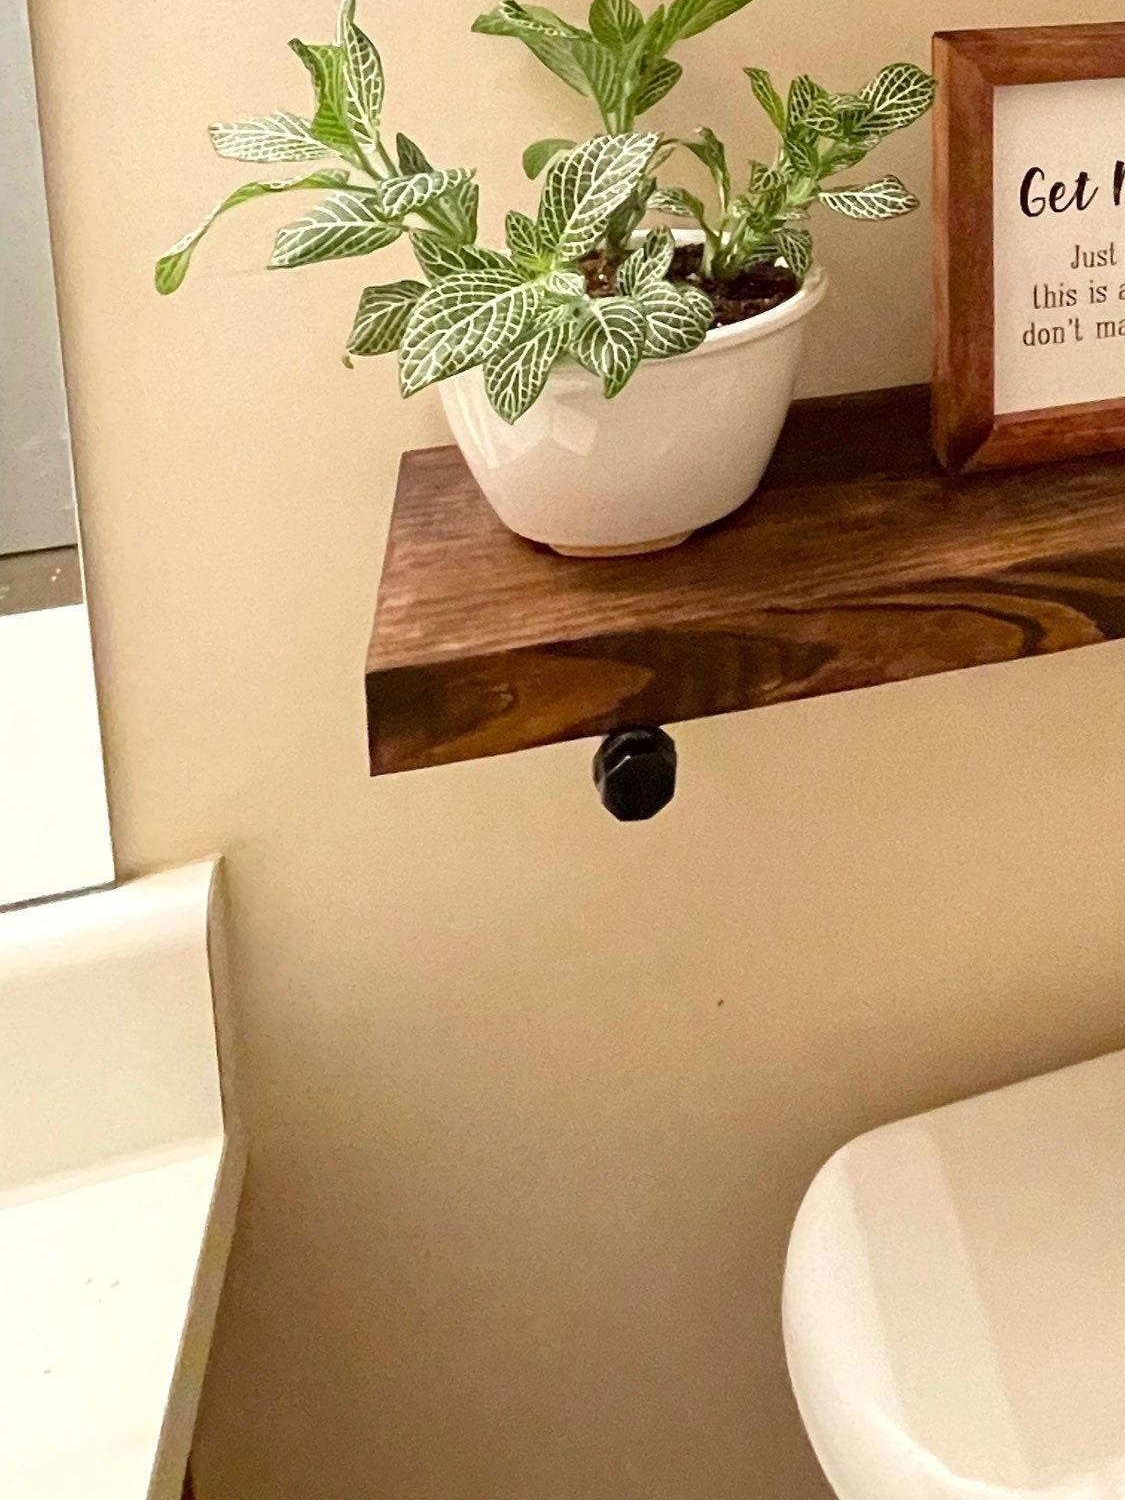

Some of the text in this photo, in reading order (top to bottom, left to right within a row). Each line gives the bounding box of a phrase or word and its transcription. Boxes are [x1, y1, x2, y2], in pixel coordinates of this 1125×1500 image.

[1019, 166, 1099, 217] Get
[1070, 242, 1118, 270] Just
[1033, 283, 1077, 310] this
[1088, 279, 1108, 304] is
[1022, 318, 1083, 347] don't
